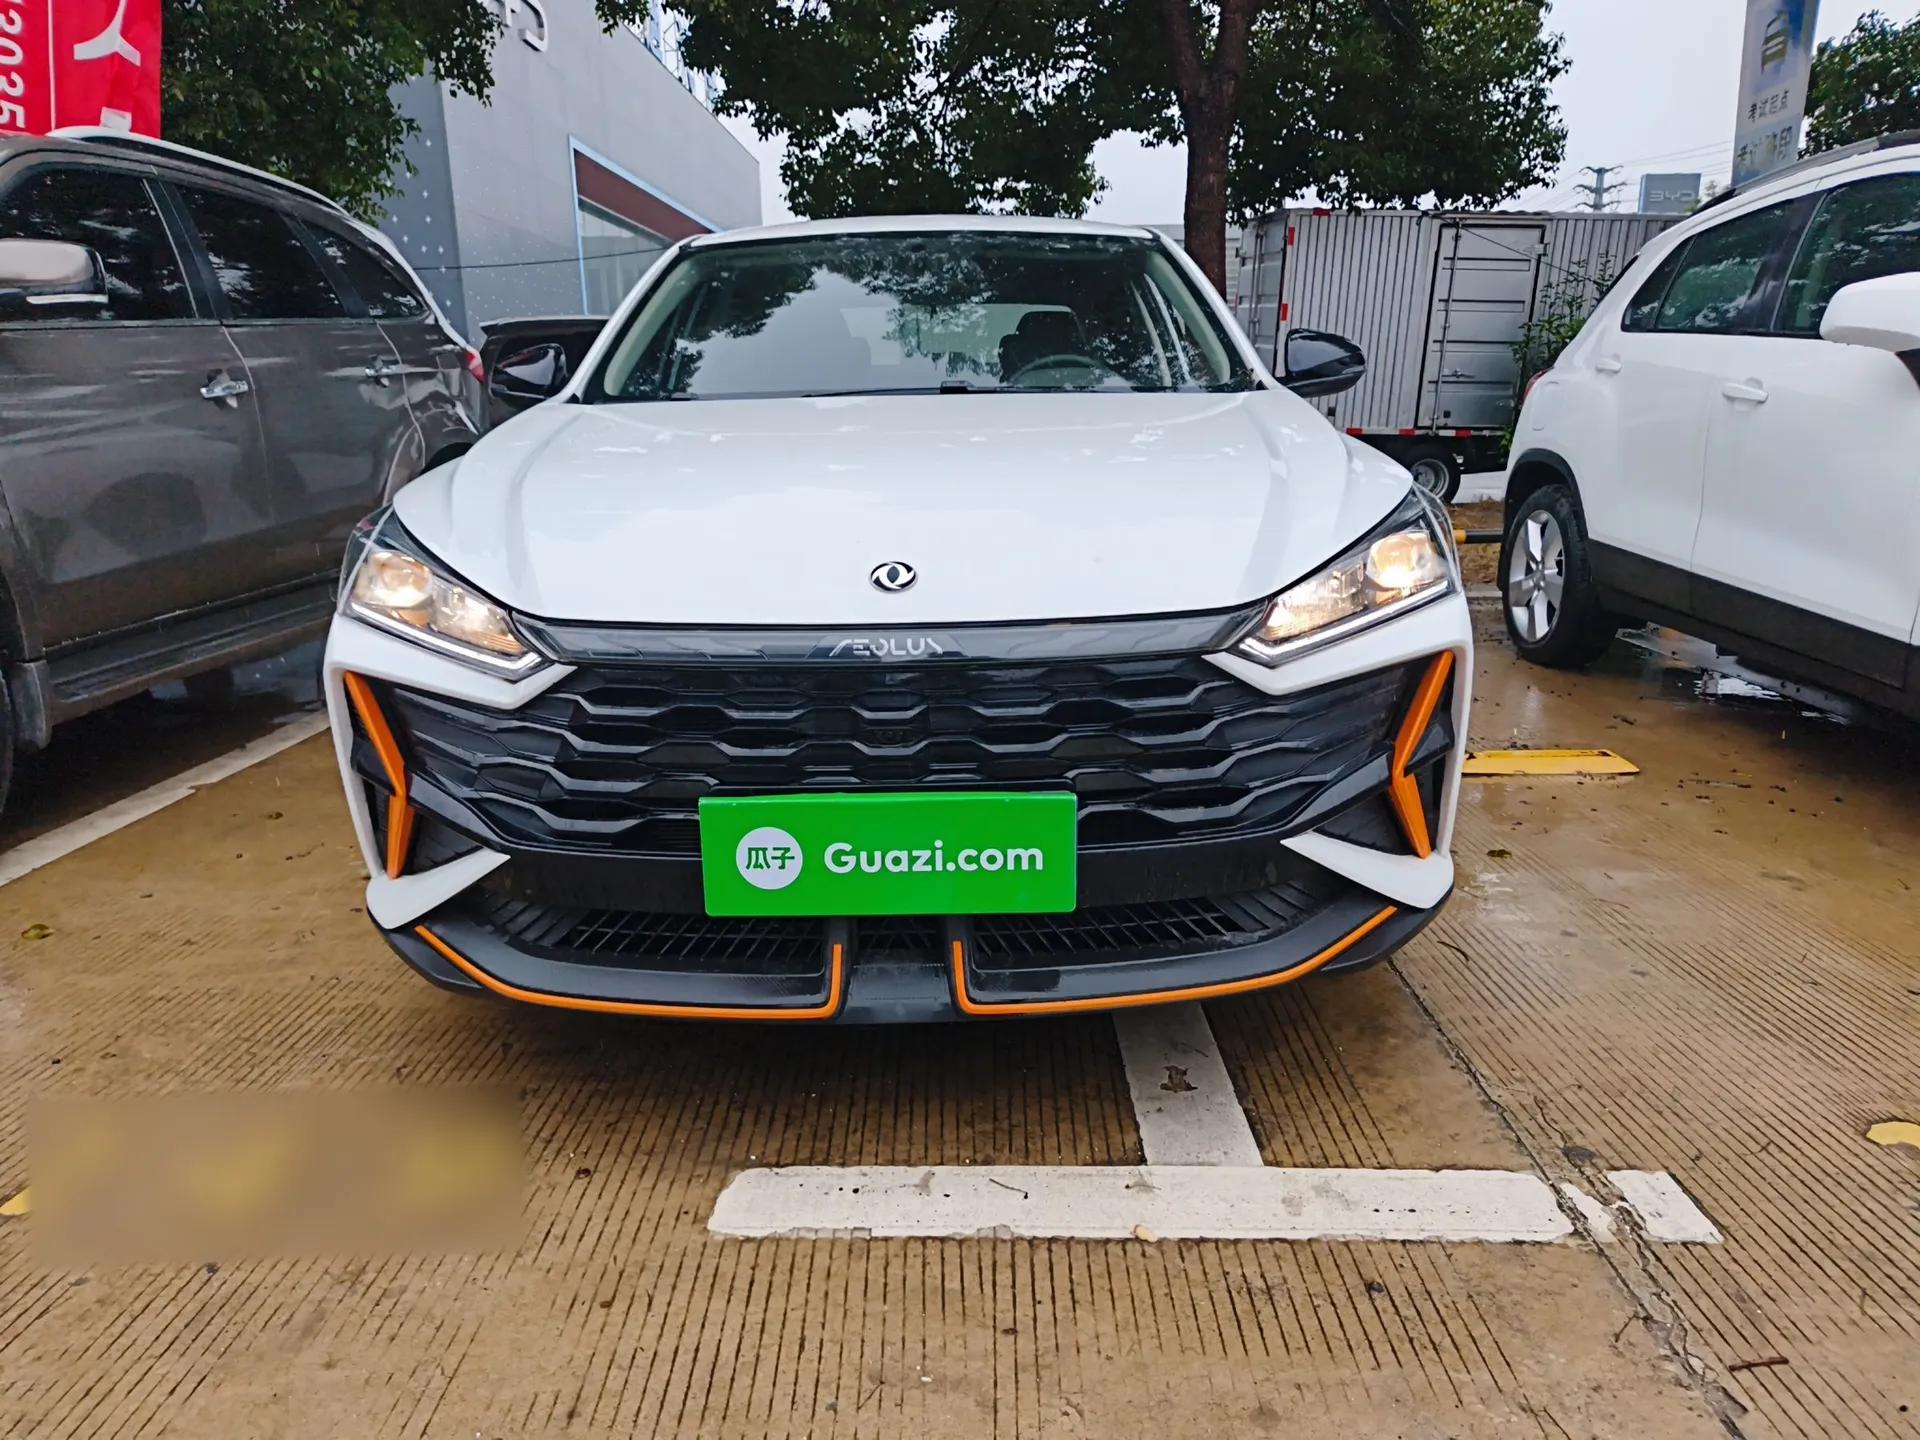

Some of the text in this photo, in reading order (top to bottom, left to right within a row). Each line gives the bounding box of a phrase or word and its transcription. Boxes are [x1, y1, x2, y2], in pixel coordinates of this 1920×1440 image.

[829, 637, 943, 656] AEOLUS
[745, 840, 1043, 874] 瓜子 Guazi.com
